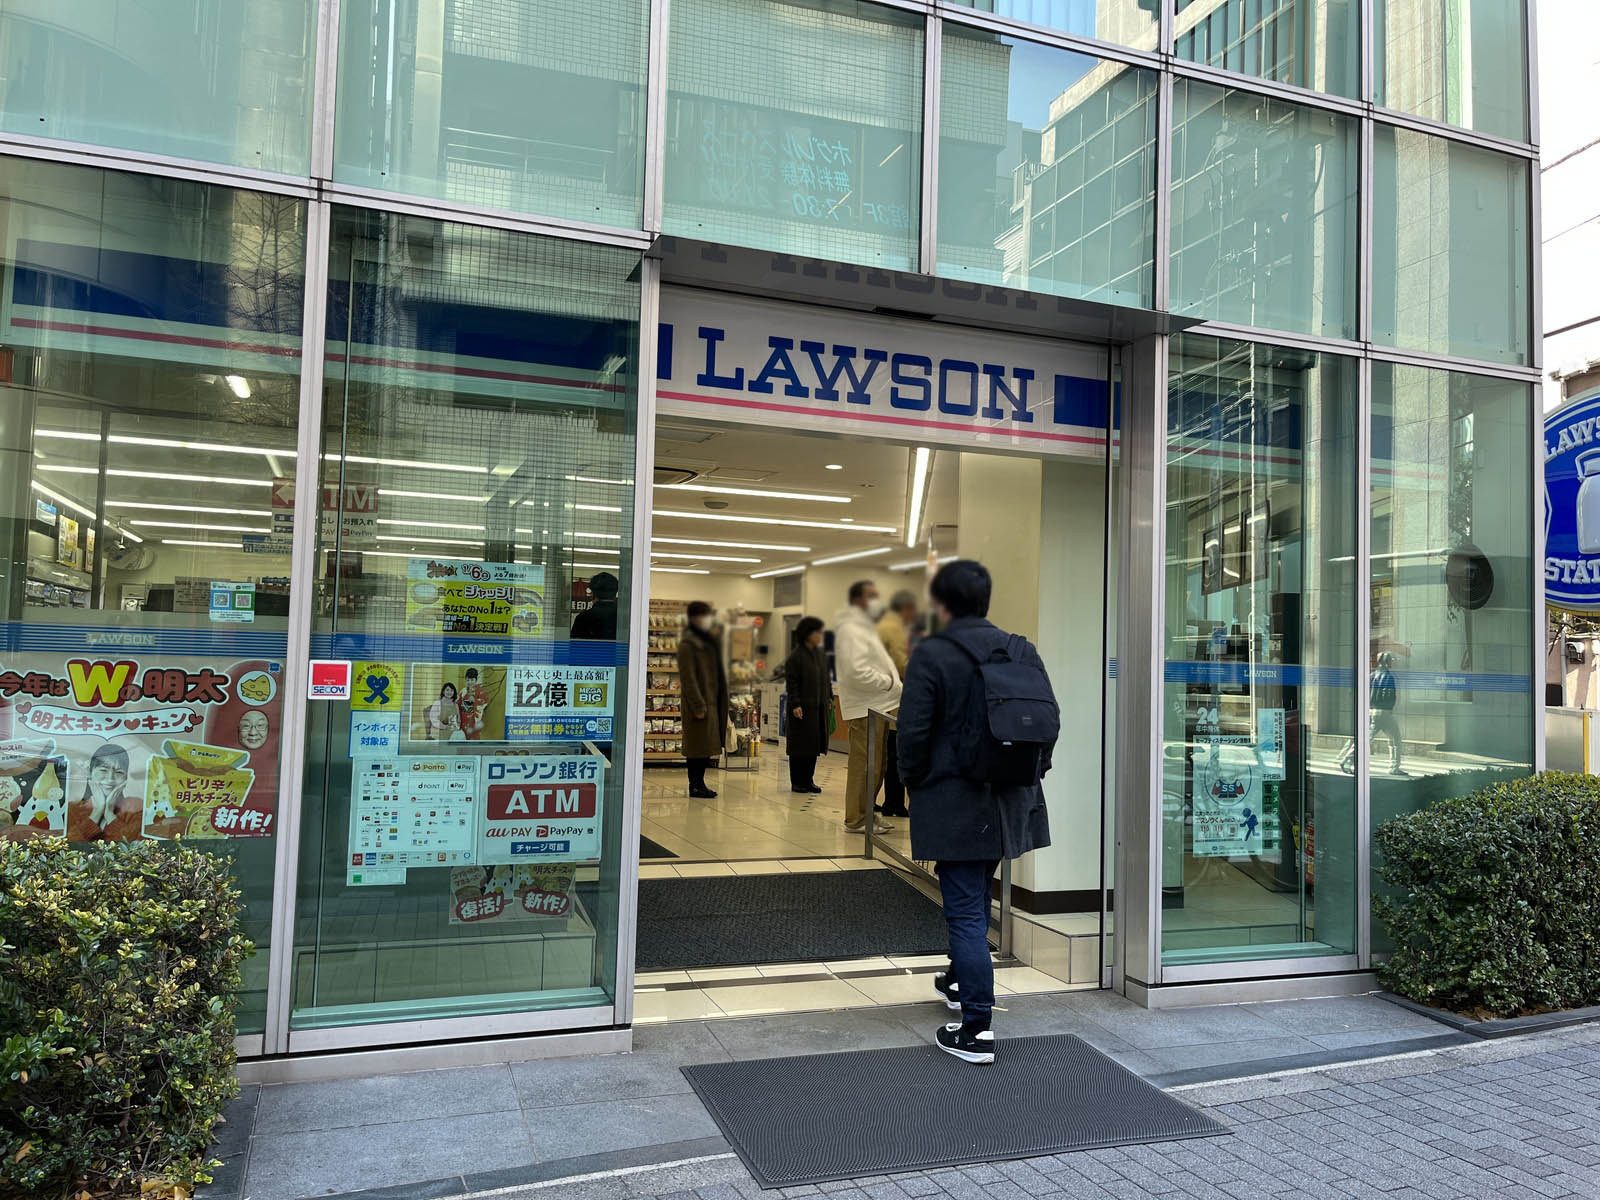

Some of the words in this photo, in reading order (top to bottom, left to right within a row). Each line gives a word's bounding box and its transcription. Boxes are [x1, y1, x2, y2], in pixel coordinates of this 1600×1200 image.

[696, 326, 1035, 423] LAWSON
[323, 484, 375, 510] TM
[87, 633, 155, 646] LAWSON
[448, 644, 504, 655] LAWSON
[513, 669, 609, 682] 日本くじ史上最高額!
[313, 685, 345, 694] SECOM
[513, 682, 568, 708] 12億
[579, 687, 603, 695] MEGA
[579, 693, 603, 703] BIG
[1196, 706, 1219, 725] 24
[360, 736, 389, 746] 対象店
[423, 763, 446, 771] Ponta
[488, 761, 598, 780] ローソン銀行
[1221, 783, 1236, 793] SS
[505, 788, 580, 814] ATM
[215, 806, 273, 833] 新作!
[486, 828, 510, 838] au
[511, 826, 532, 837] PAY
[550, 826, 584, 837] PayPay
[516, 842, 565, 853] チャージ可能
[461, 896, 501, 919] 復活!
[525, 892, 568, 913] 新作!
